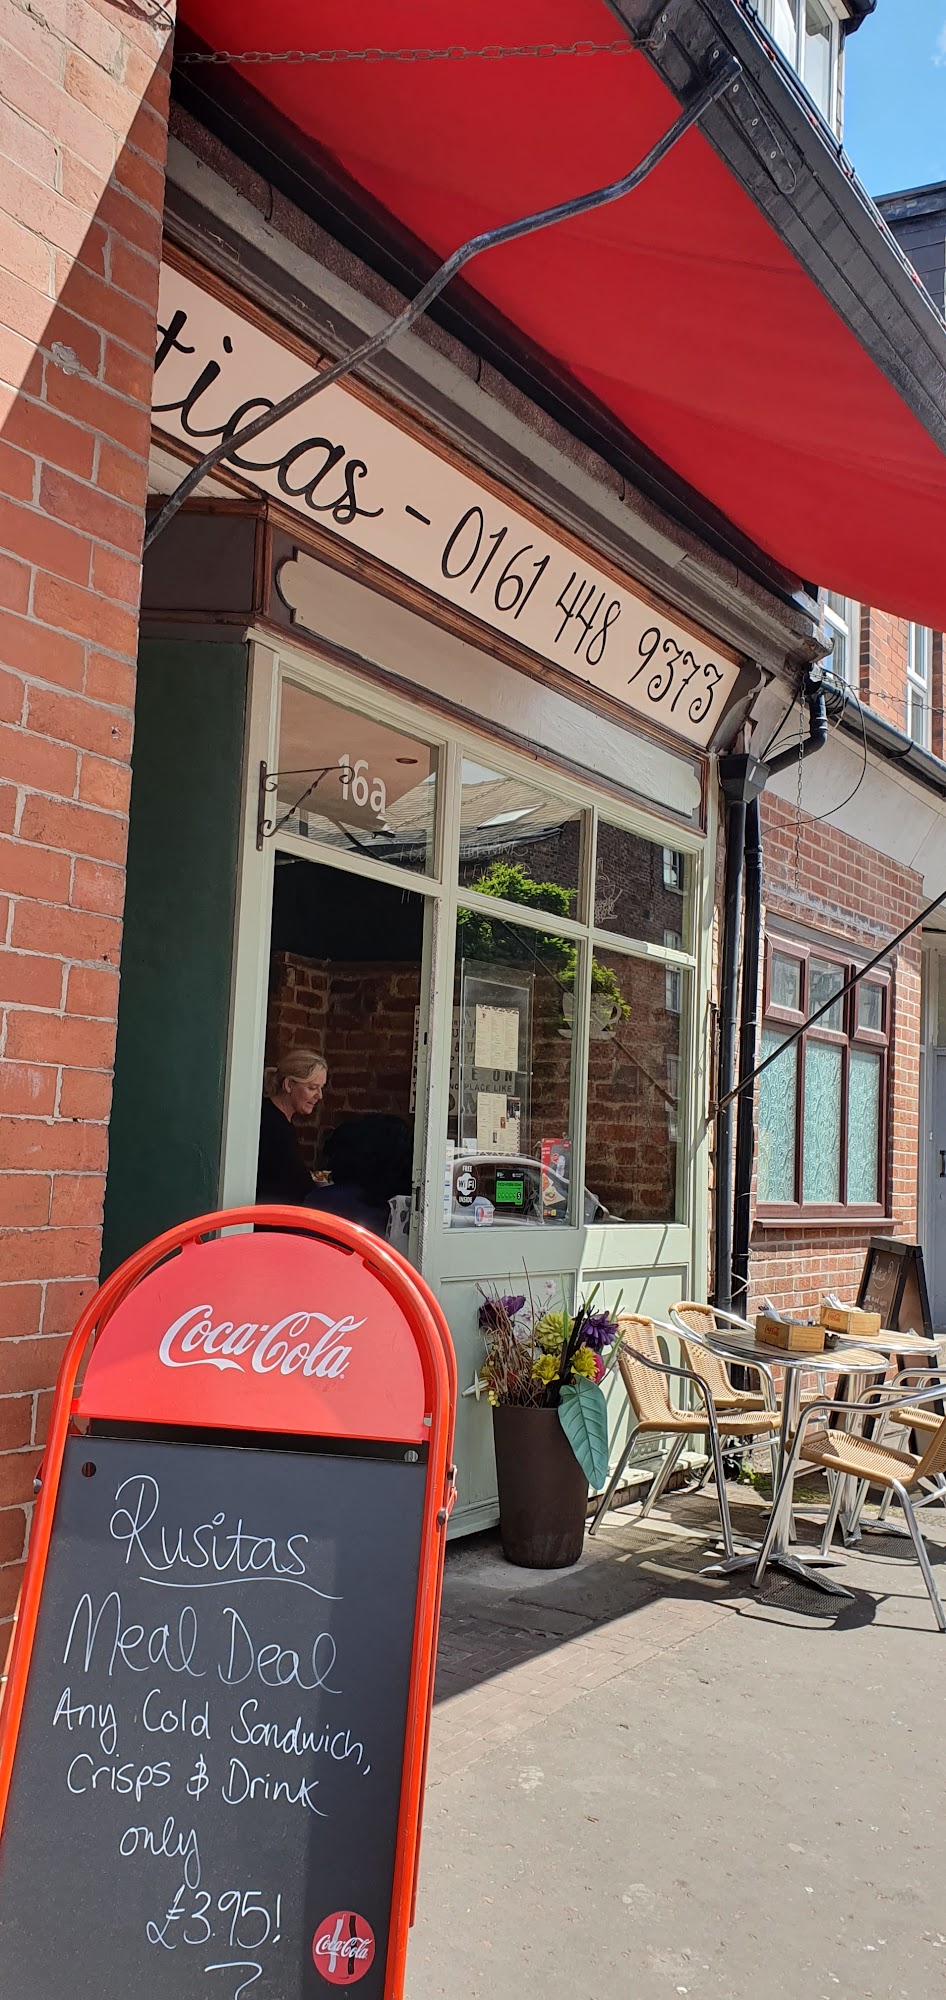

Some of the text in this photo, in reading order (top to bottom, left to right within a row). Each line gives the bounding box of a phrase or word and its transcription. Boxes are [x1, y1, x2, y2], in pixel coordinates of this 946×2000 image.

[441, 506, 550, 620] 0161
[555, 572, 621, 666] 448
[627, 627, 724, 724] 9373
[338, 753, 387, 814] 16a
[464, 1083, 491, 1092] PLACE
[493, 1084, 512, 1093] LIKE
[462, 1165, 473, 1173] FREE
[158, 1304, 368, 1379] Coca-Cola
[110, 1474, 309, 1576] Rusitas
[63, 1591, 343, 1694] Meal Deal
[52, 1686, 371, 1775] Any Cold Sandwich,
[67, 1753, 172, 1802] Crisps
[119, 1816, 201, 1889] only
[315, 1934, 373, 1960] Coca-Cola
